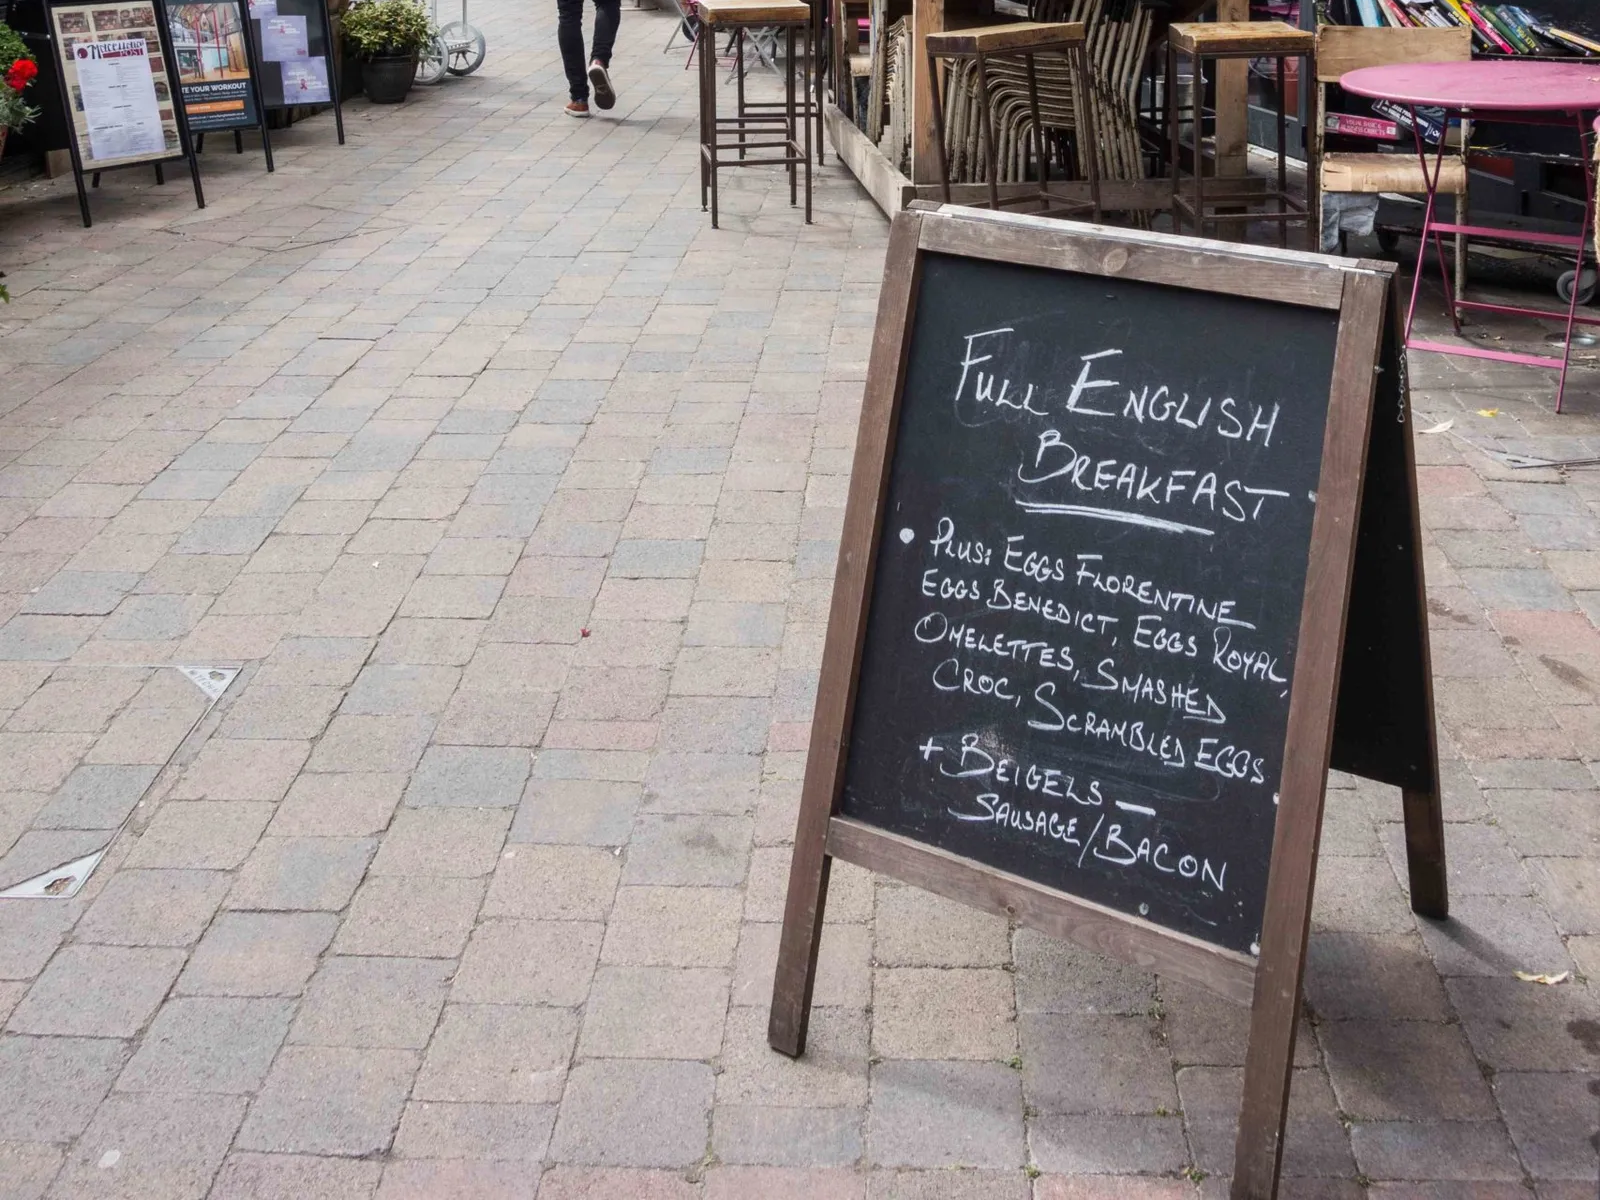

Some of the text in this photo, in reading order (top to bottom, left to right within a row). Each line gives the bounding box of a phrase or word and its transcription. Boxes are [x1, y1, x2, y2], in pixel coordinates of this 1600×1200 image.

[190, 85, 210, 93] YOUR
[210, 82, 247, 91] WORKOUT
[1018, 430, 1290, 522] BREAKFAST
[921, 568, 981, 601] EGGS
[1132, 615, 1198, 657] EGGS
[1003, 535, 1065, 582] EGGS
[1076, 554, 1256, 630] FLORENTINE
[1027, 681, 1185, 767] SCRAMBLED
[1194, 737, 1266, 785] EGGS
[1081, 658, 1227, 724] SMASHED
[940, 733, 1103, 806] BEIGELS
